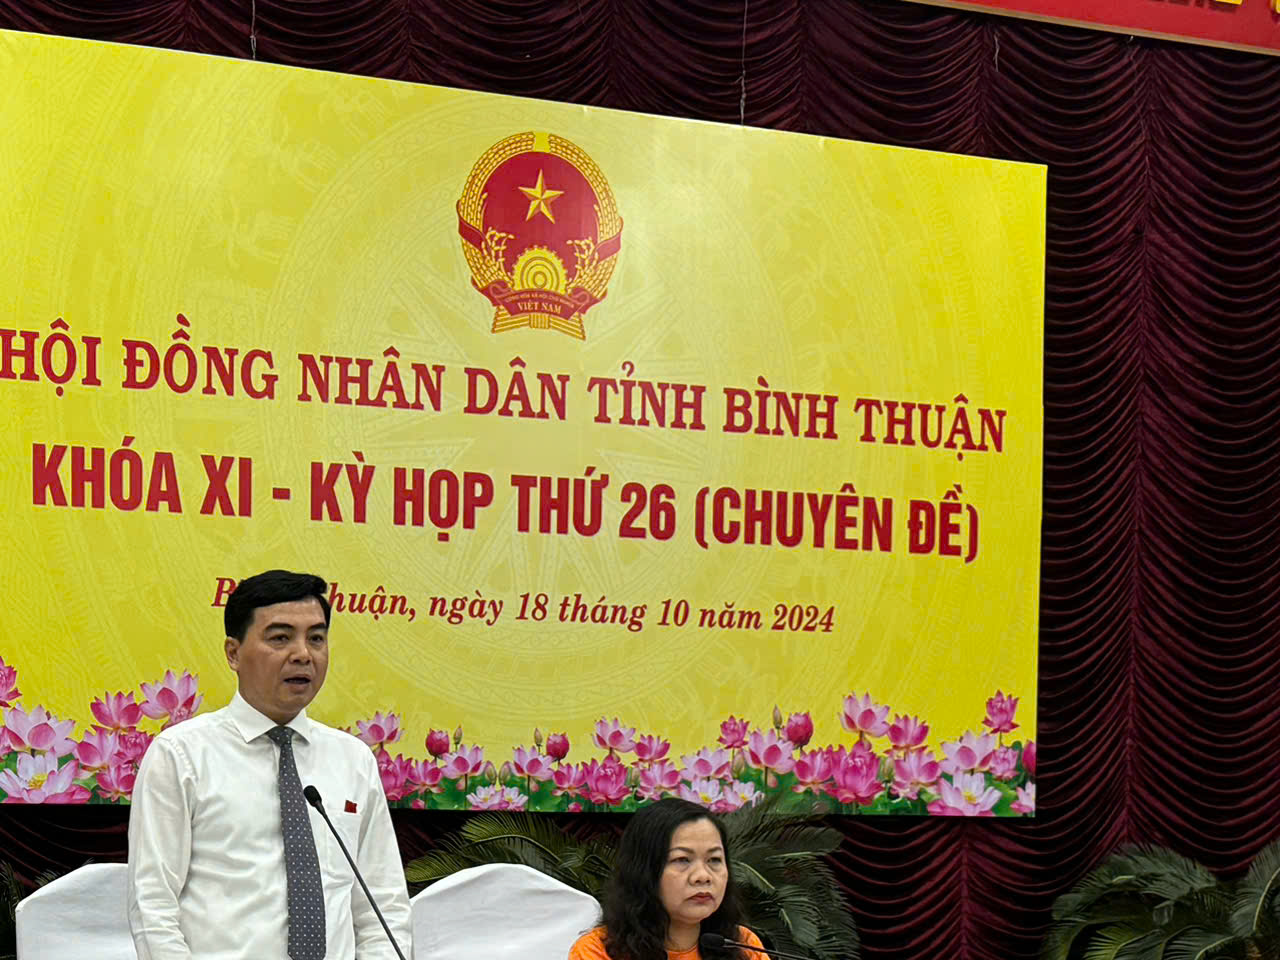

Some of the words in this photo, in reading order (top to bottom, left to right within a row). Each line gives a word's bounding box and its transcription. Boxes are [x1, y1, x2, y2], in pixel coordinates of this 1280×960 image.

[541, 302, 562, 315] NAM
[121, 313, 279, 400] ĐỒNG
[297, 346, 446, 412] NHÂN
[463, 356, 570, 423] DÂN
[587, 361, 707, 431] TỈNH
[723, 376, 839, 441] BÌNH
[854, 394, 1007, 461] THUẬN
[31, 435, 184, 515] KHÓA
[199, 454, 253, 519] XI
[272, 486, 291, 501] -
[310, 450, 376, 525] KỲ
[392, 467, 495, 543] HỌP
[510, 466, 610, 538] THỨ
[619, 481, 677, 543] 26
[695, 483, 893, 554] (CHUYÊN
[907, 484, 980, 564] ĐỀ)
[327, 582, 417, 623] huận,
[428, 590, 504, 626] ngày
[515, 592, 550, 622] 18
[558, 593, 648, 633] tháng
[656, 598, 691, 627] 10
[698, 601, 763, 631] năm
[771, 603, 836, 634] 2024
